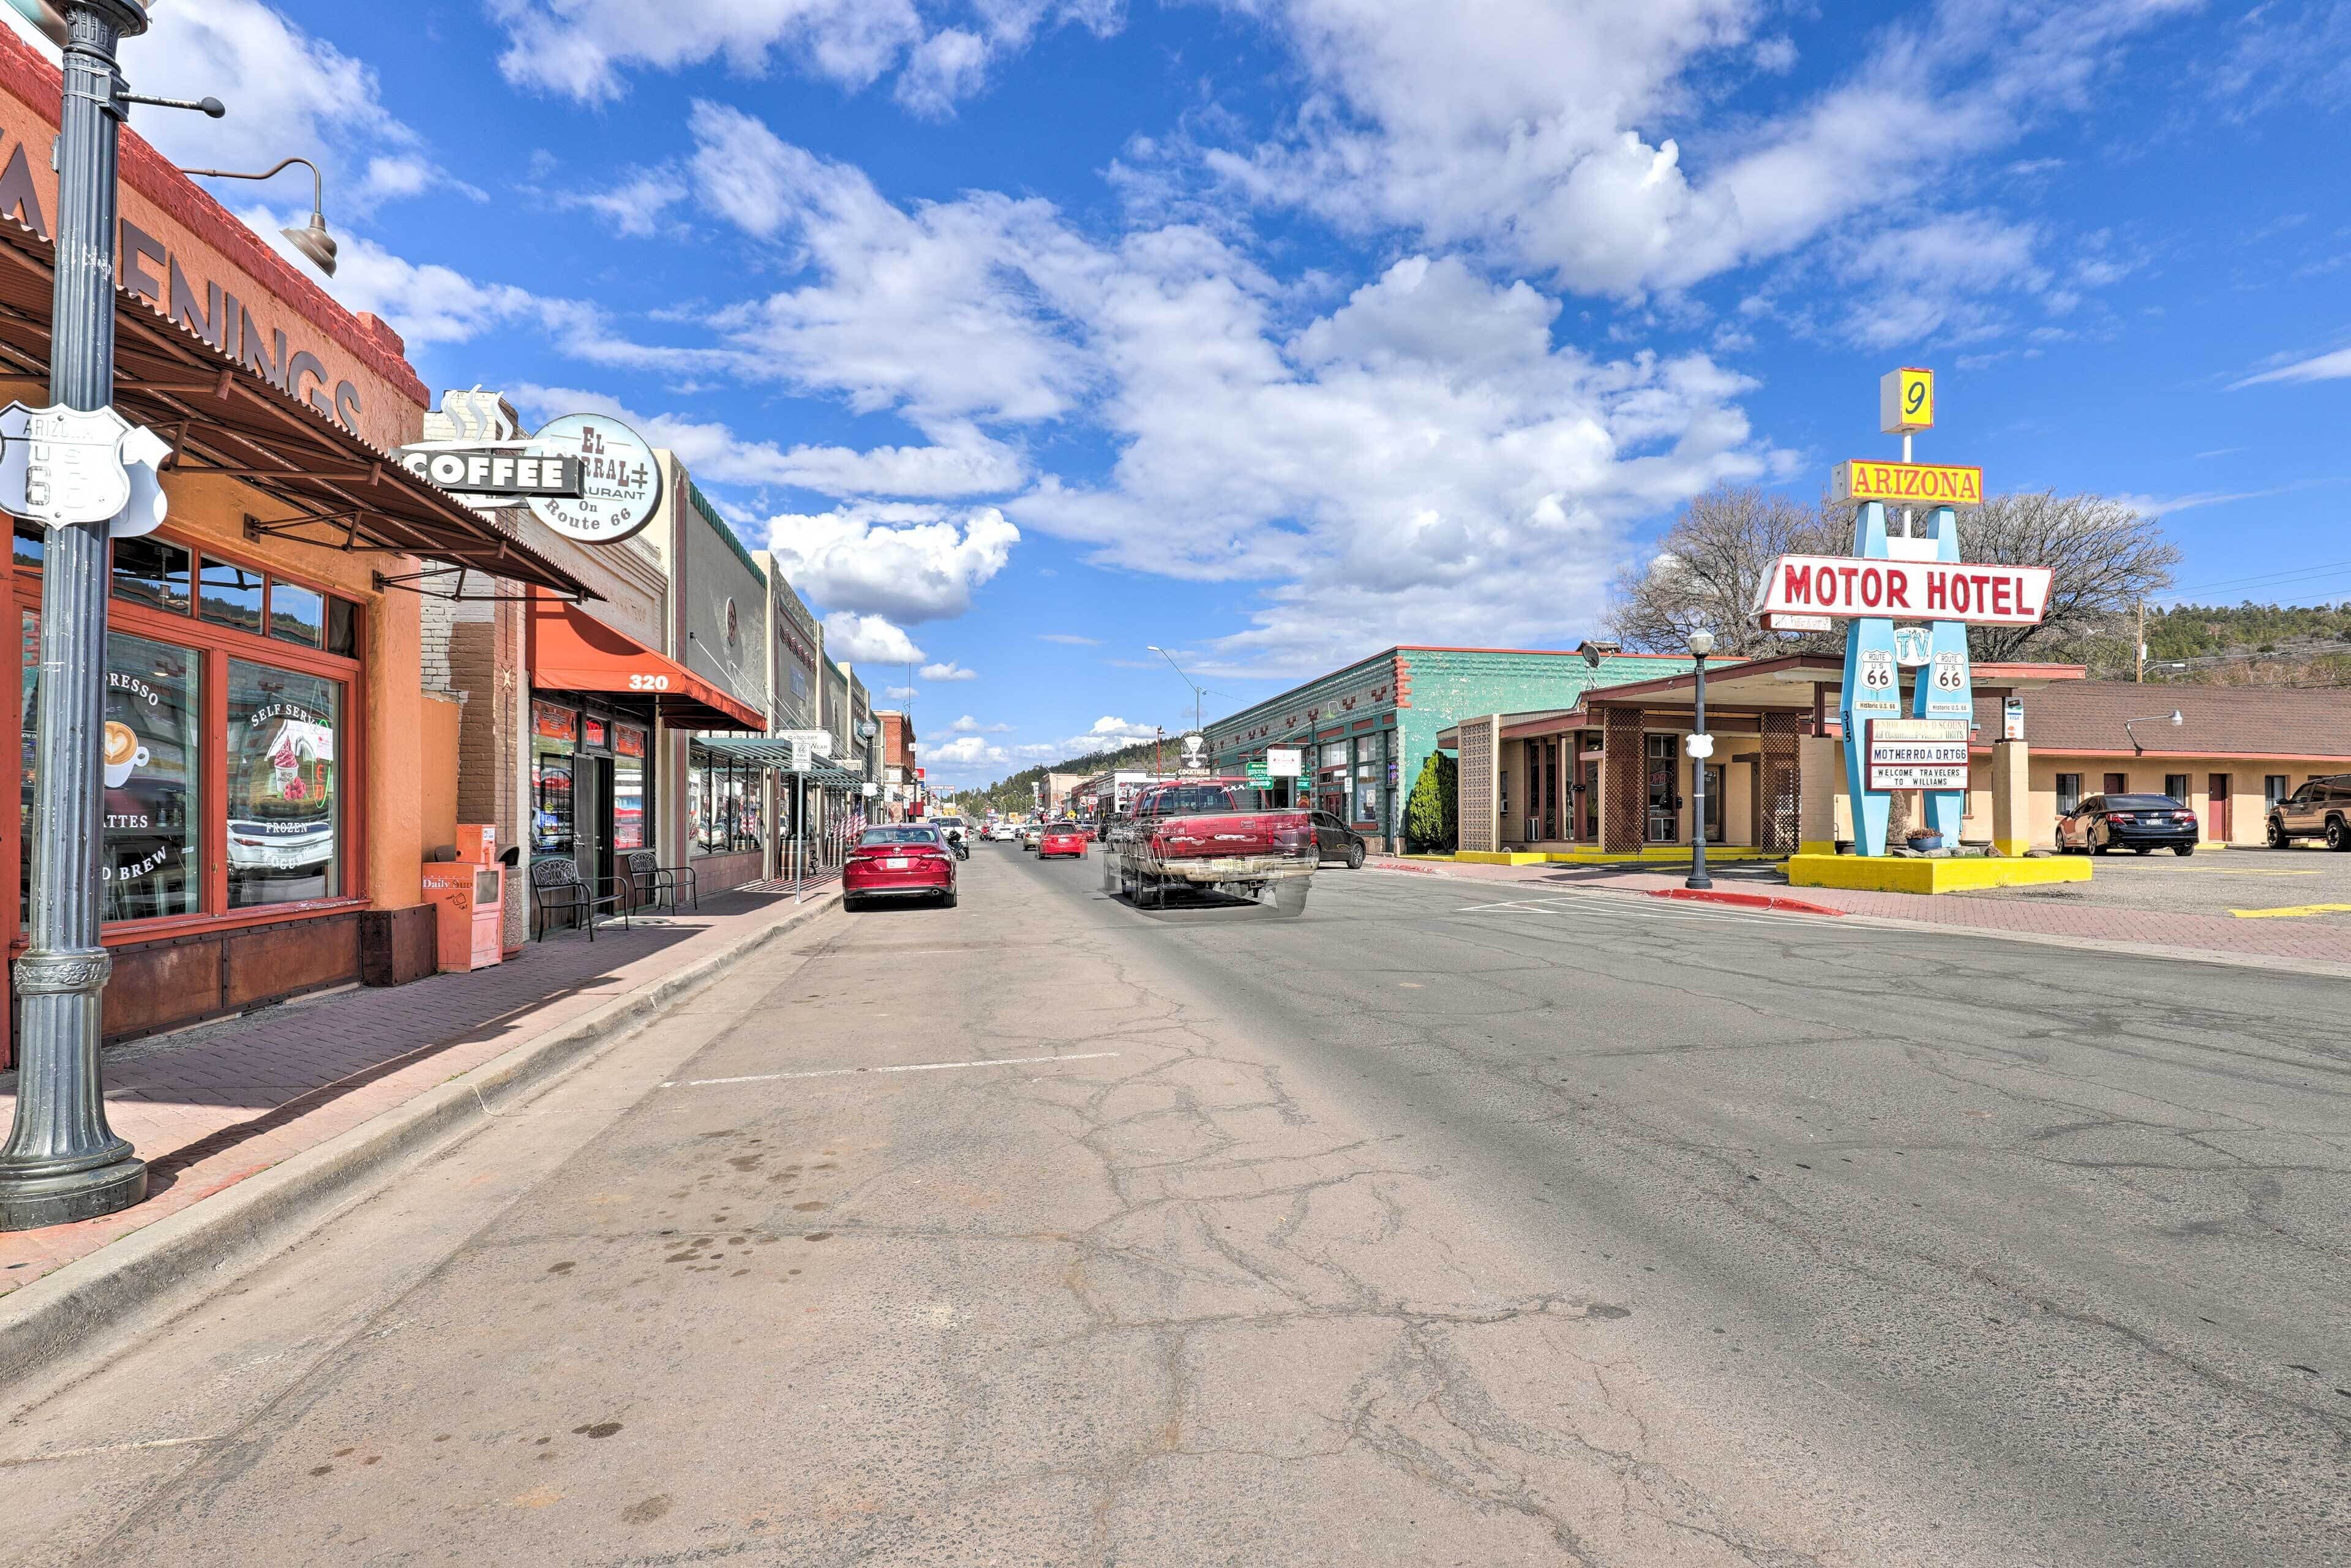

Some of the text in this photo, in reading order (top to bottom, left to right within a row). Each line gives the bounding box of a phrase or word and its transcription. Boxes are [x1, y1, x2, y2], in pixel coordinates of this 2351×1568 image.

[1906, 381, 1925, 415] 9
[23, 418, 94, 439] ARIZO
[582, 426, 604, 455] EL
[402, 452, 563, 488] COFFEE
[1853, 467, 1977, 499] ARIZONA
[544, 498, 631, 530] Route 66
[579, 500, 598, 512] On
[1785, 565, 2034, 615] MOTOR HOTEL
[1896, 631, 1930, 662] TV
[105, 673, 158, 706] RESSO
[629, 674, 669, 690] 320
[1867, 670, 1888, 685] 66
[1940, 672, 1961, 687] 66
[251, 704, 281, 727] SELF
[1843, 710, 1851, 743] 315
[1932, 721, 1966, 729] DSCOUNT
[266, 822, 307, 833] FROZEN
[119, 846, 167, 880] BREW
[423, 879, 450, 889] Daily
